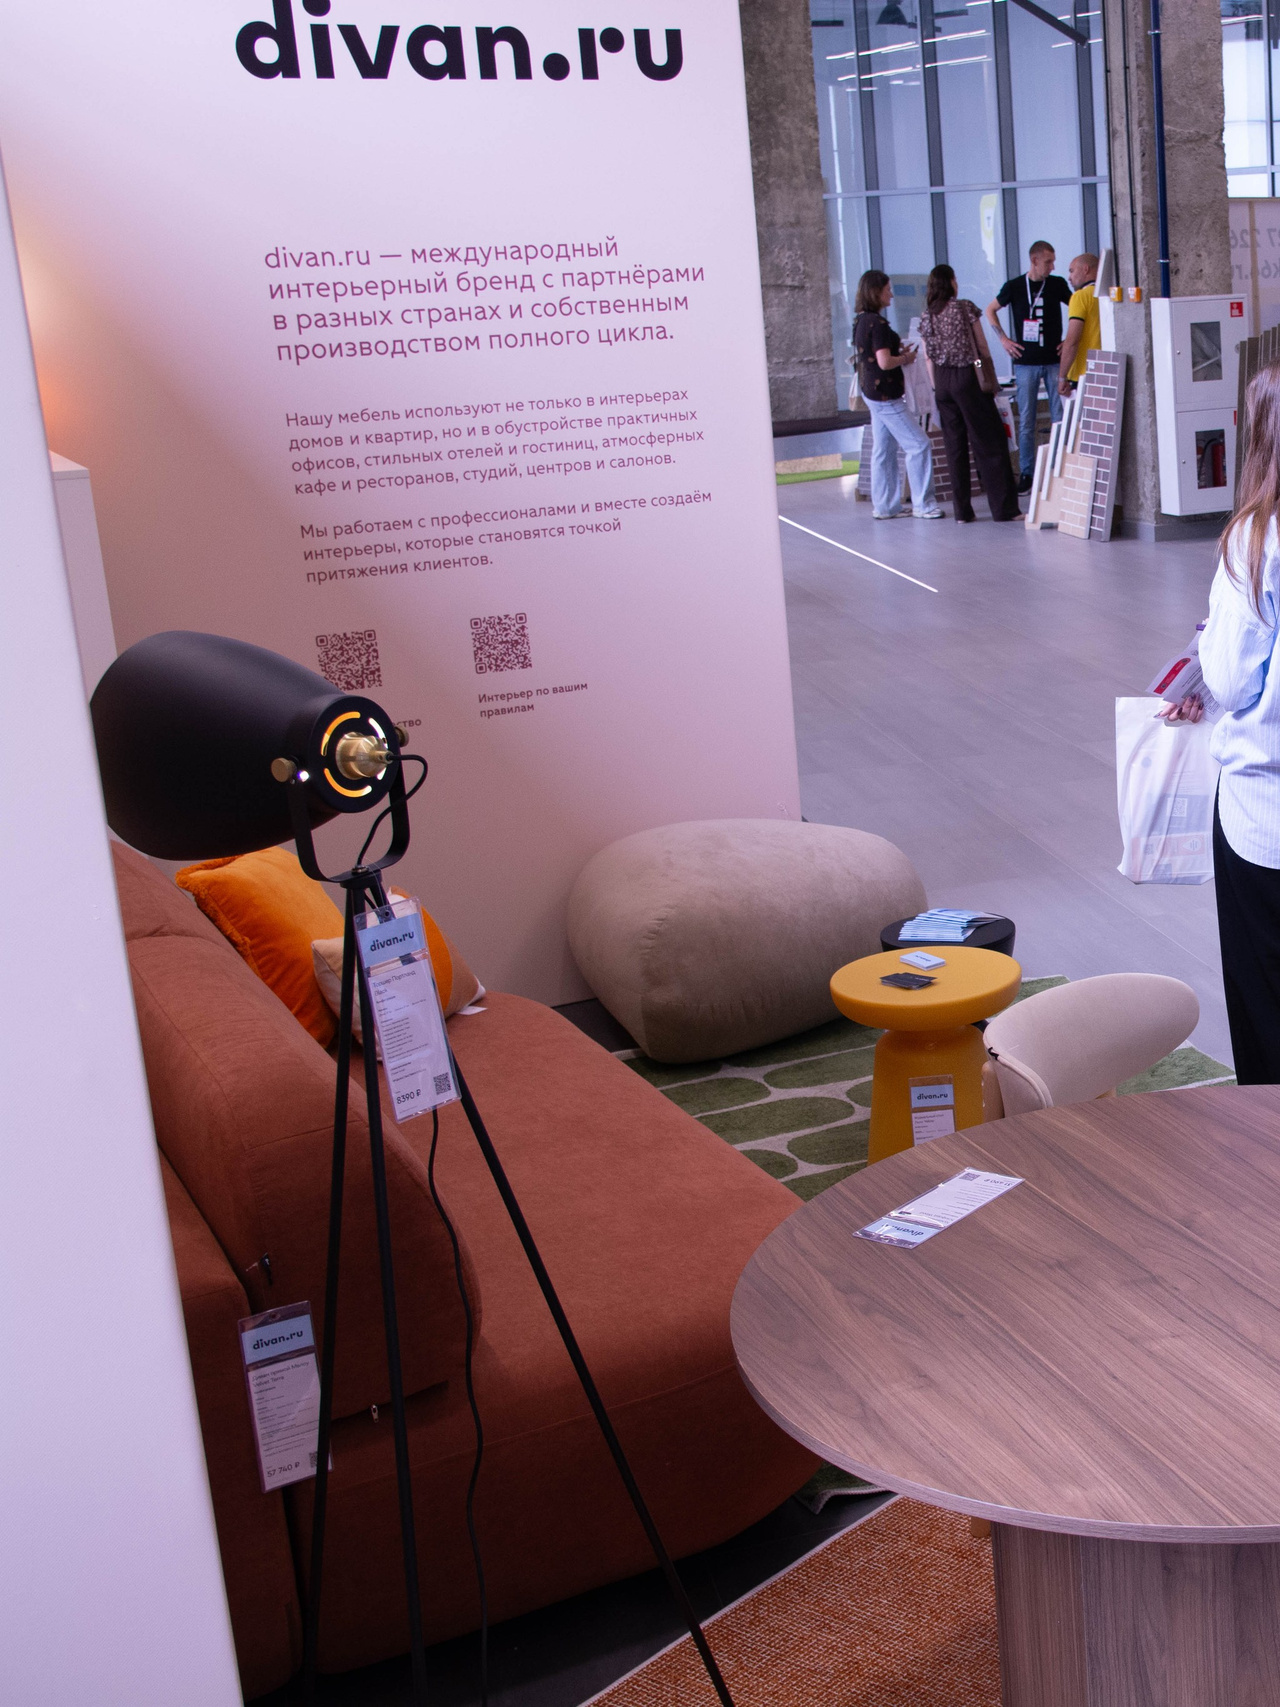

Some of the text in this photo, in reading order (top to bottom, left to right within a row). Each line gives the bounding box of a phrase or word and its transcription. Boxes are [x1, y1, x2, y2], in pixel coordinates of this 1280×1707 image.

[235, 0, 684, 81] divan.ru
[265, 246, 370, 269] divan.ru
[411, 236, 618, 267] международный
[269, 264, 704, 303] интерьерный бренд с партнёрами
[273, 296, 688, 335] в разных странах и собственным
[277, 325, 674, 366] производством полного цикла.
[286, 390, 688, 429] Нашу мебель используют не только в интерьерах
[289, 411, 697, 452] домов и квартир, но и в обустройстве практичных
[292, 431, 704, 475] офисов, стильных отелей и гостиниц, атмосферных
[295, 454, 676, 496] кафе и ресторанов, студий, центров и салонов.
[300, 490, 712, 539] Мы работаем с профессионалами и вместе создаём
[303, 517, 621, 561] интерьеры, которые становятся точкой
[306, 555, 493, 585] притяжения клиентов.
[478, 683, 588, 703] Интерьер по вашим
[480, 704, 535, 719] правилам
[370, 931, 414, 952] divan.ru
[396, 1092, 414, 1104] 8390
[252, 1330, 304, 1350] divan.ru
